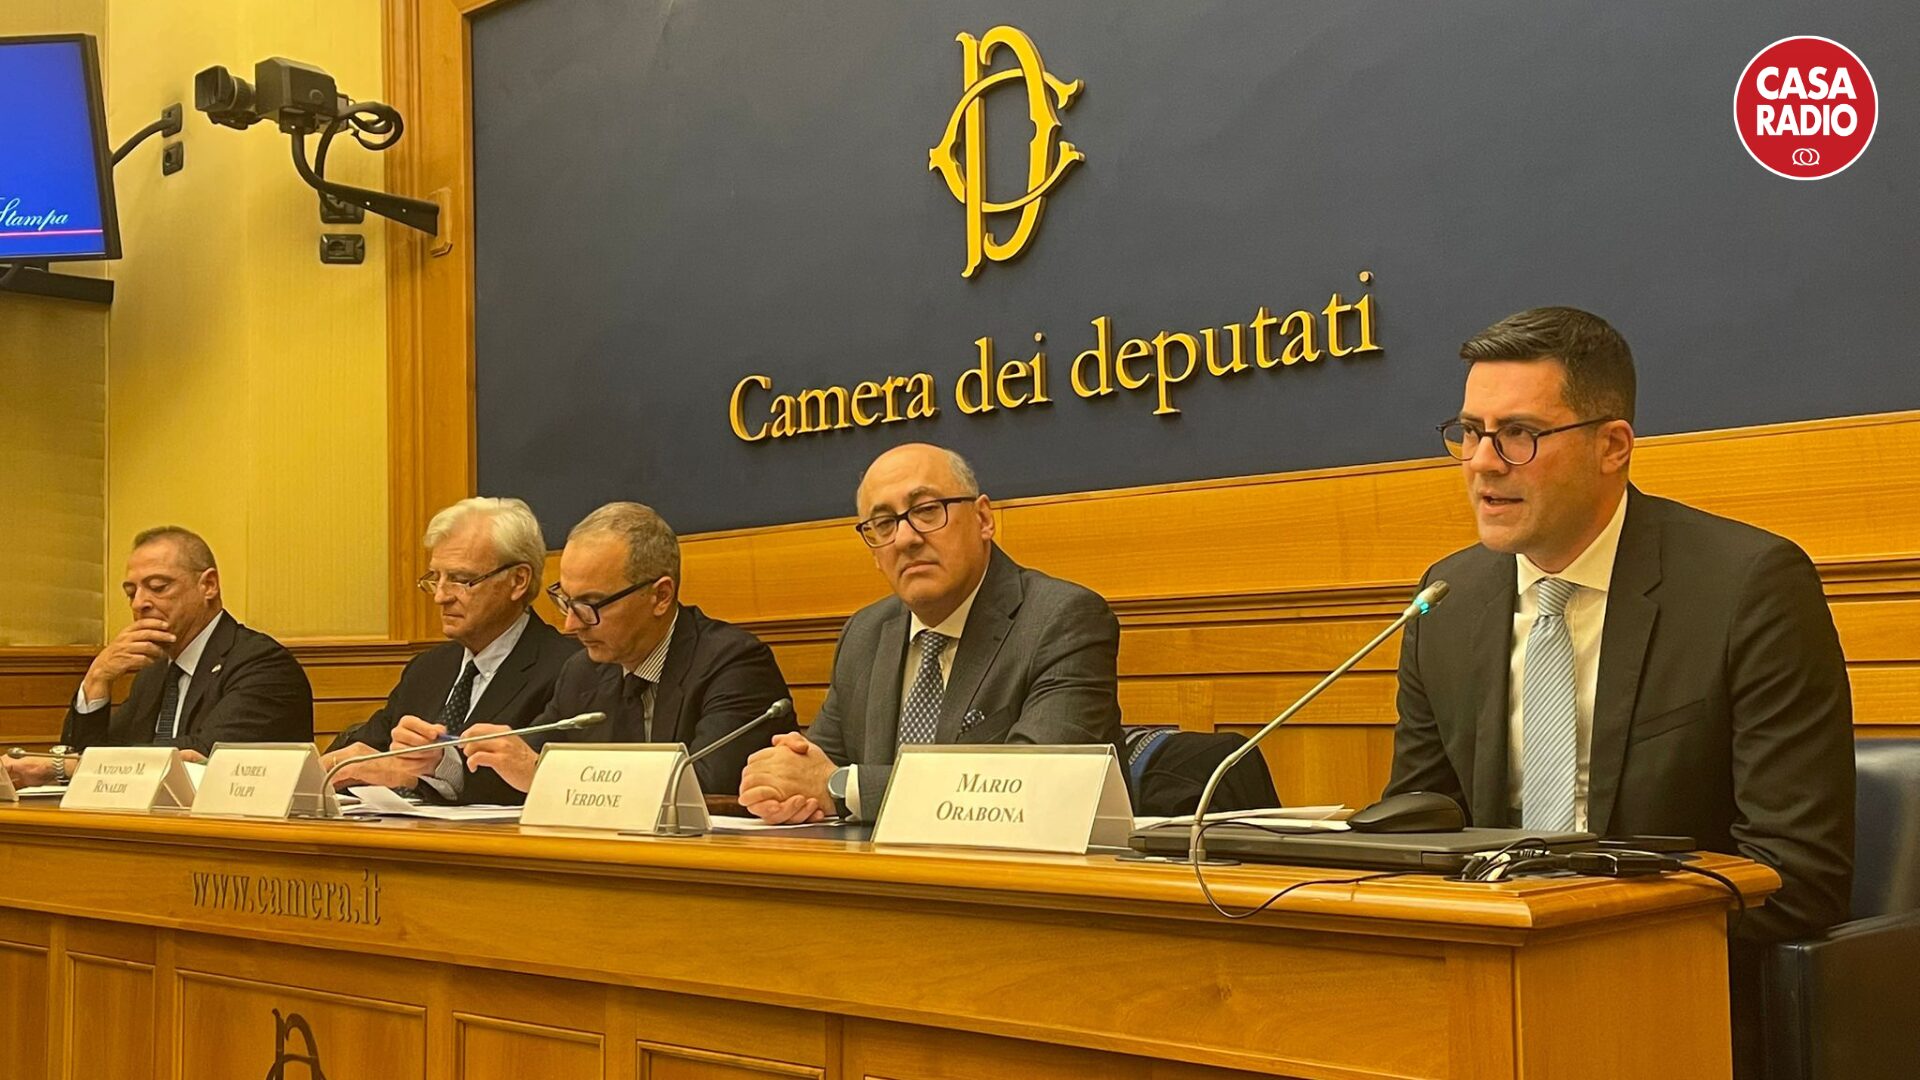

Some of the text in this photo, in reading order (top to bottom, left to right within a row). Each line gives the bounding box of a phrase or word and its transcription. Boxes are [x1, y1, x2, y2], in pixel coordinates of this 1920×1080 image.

[729, 270, 1384, 442] Camera dei deputati
[230, 762, 268, 777] ANDREA
[579, 765, 623, 784] CARLO
[229, 782, 256, 798] VOLPI
[955, 773, 1022, 794] MARIO
[565, 788, 622, 808] VERDONE
[936, 800, 1025, 824] ORABONA
[192, 868, 382, 926] www.camera.it
